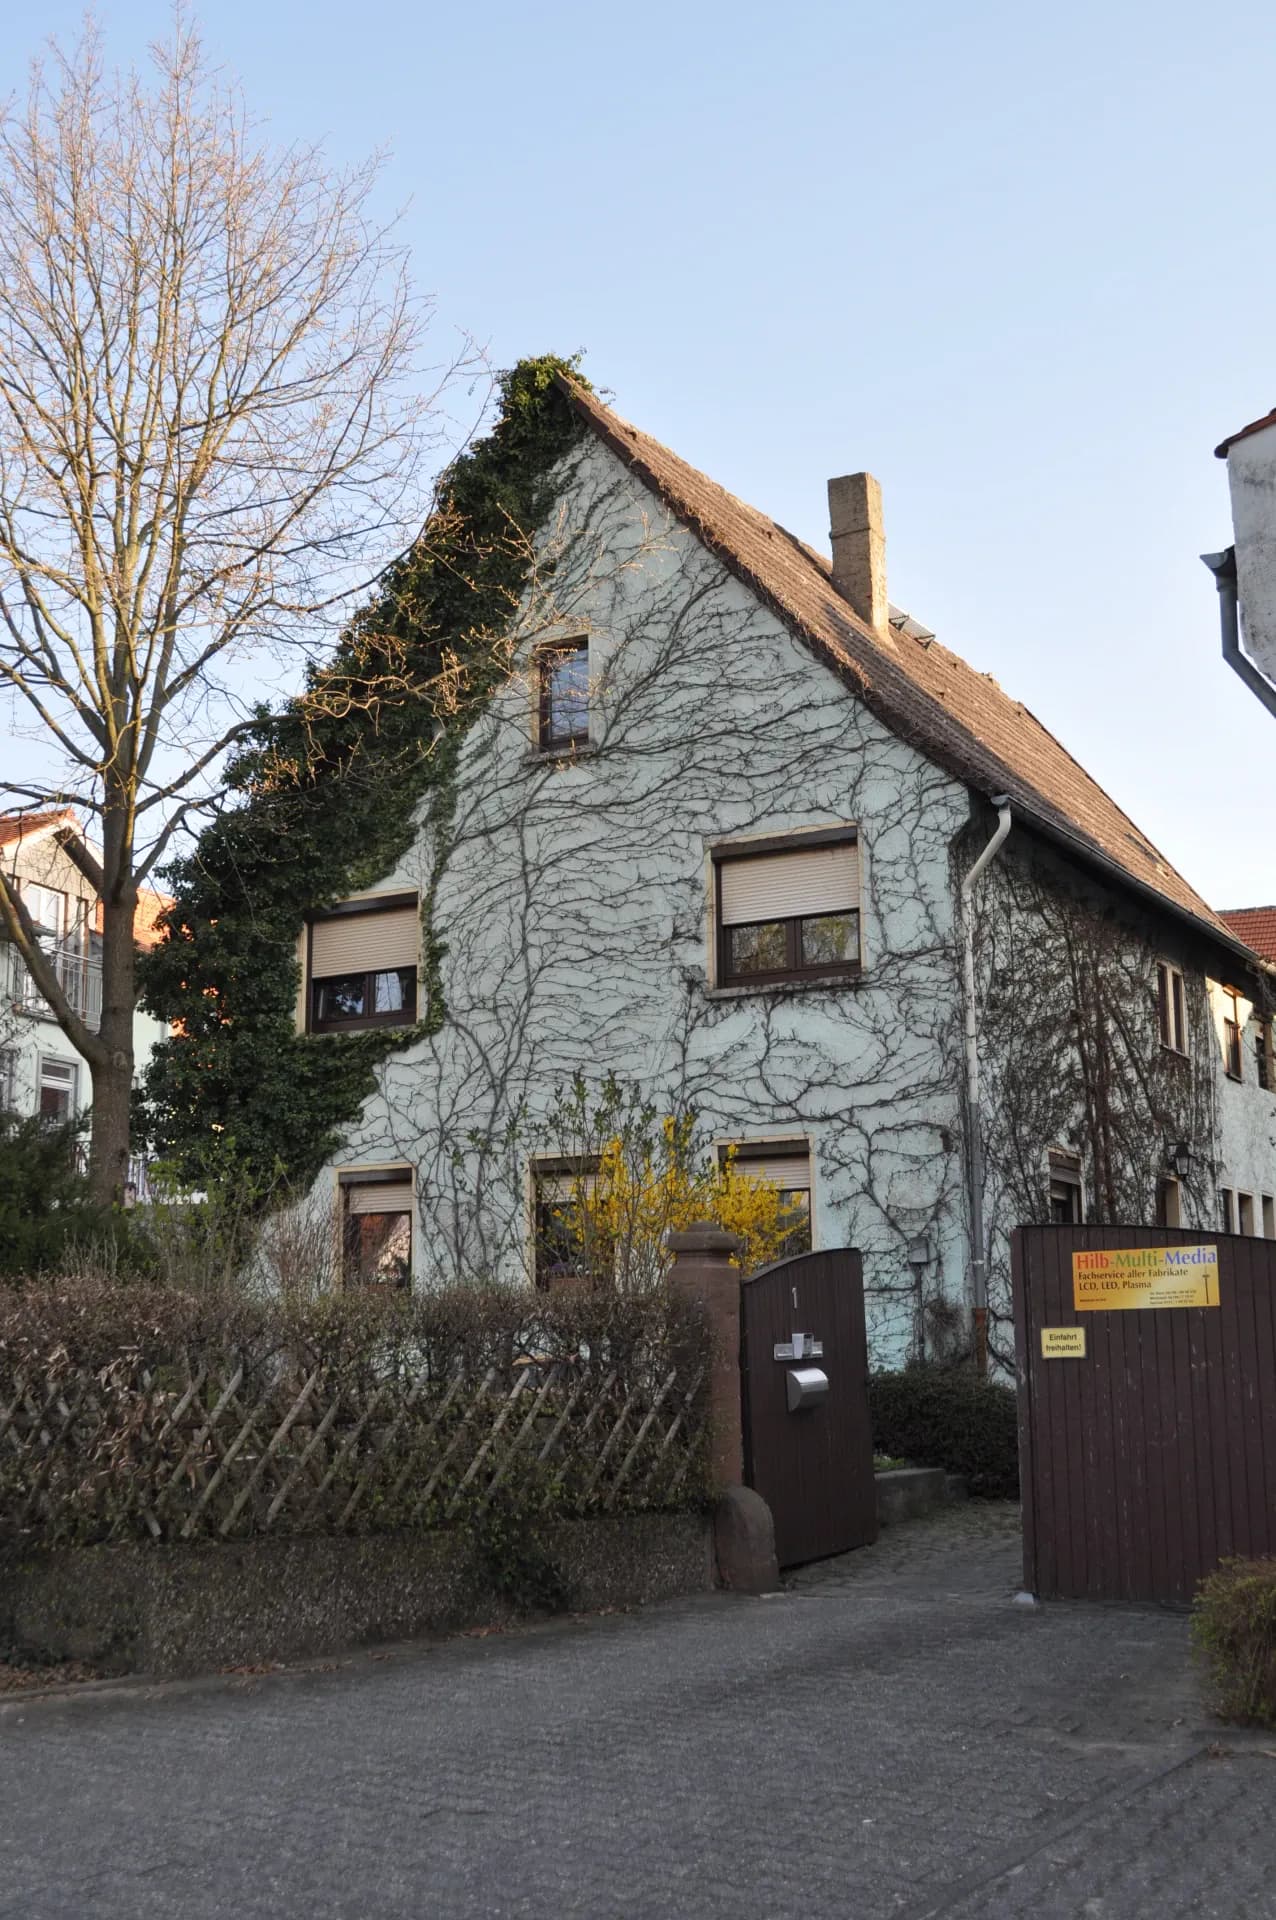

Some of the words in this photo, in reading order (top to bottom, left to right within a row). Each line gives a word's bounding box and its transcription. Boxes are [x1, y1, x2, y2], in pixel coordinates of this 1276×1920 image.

[1077, 1248, 1216, 1269] Hilb-Multi-Media
[1078, 1271, 1125, 1281] Fachservice
[1127, 1269, 1146, 1279] aller
[1148, 1268, 1188, 1278] Fabrikate
[1079, 1281, 1099, 1291] LCD,
[1101, 1281, 1120, 1291] LED,
[1122, 1280, 1152, 1289] Plasma
[1049, 1333, 1077, 1341] Einfahrt
